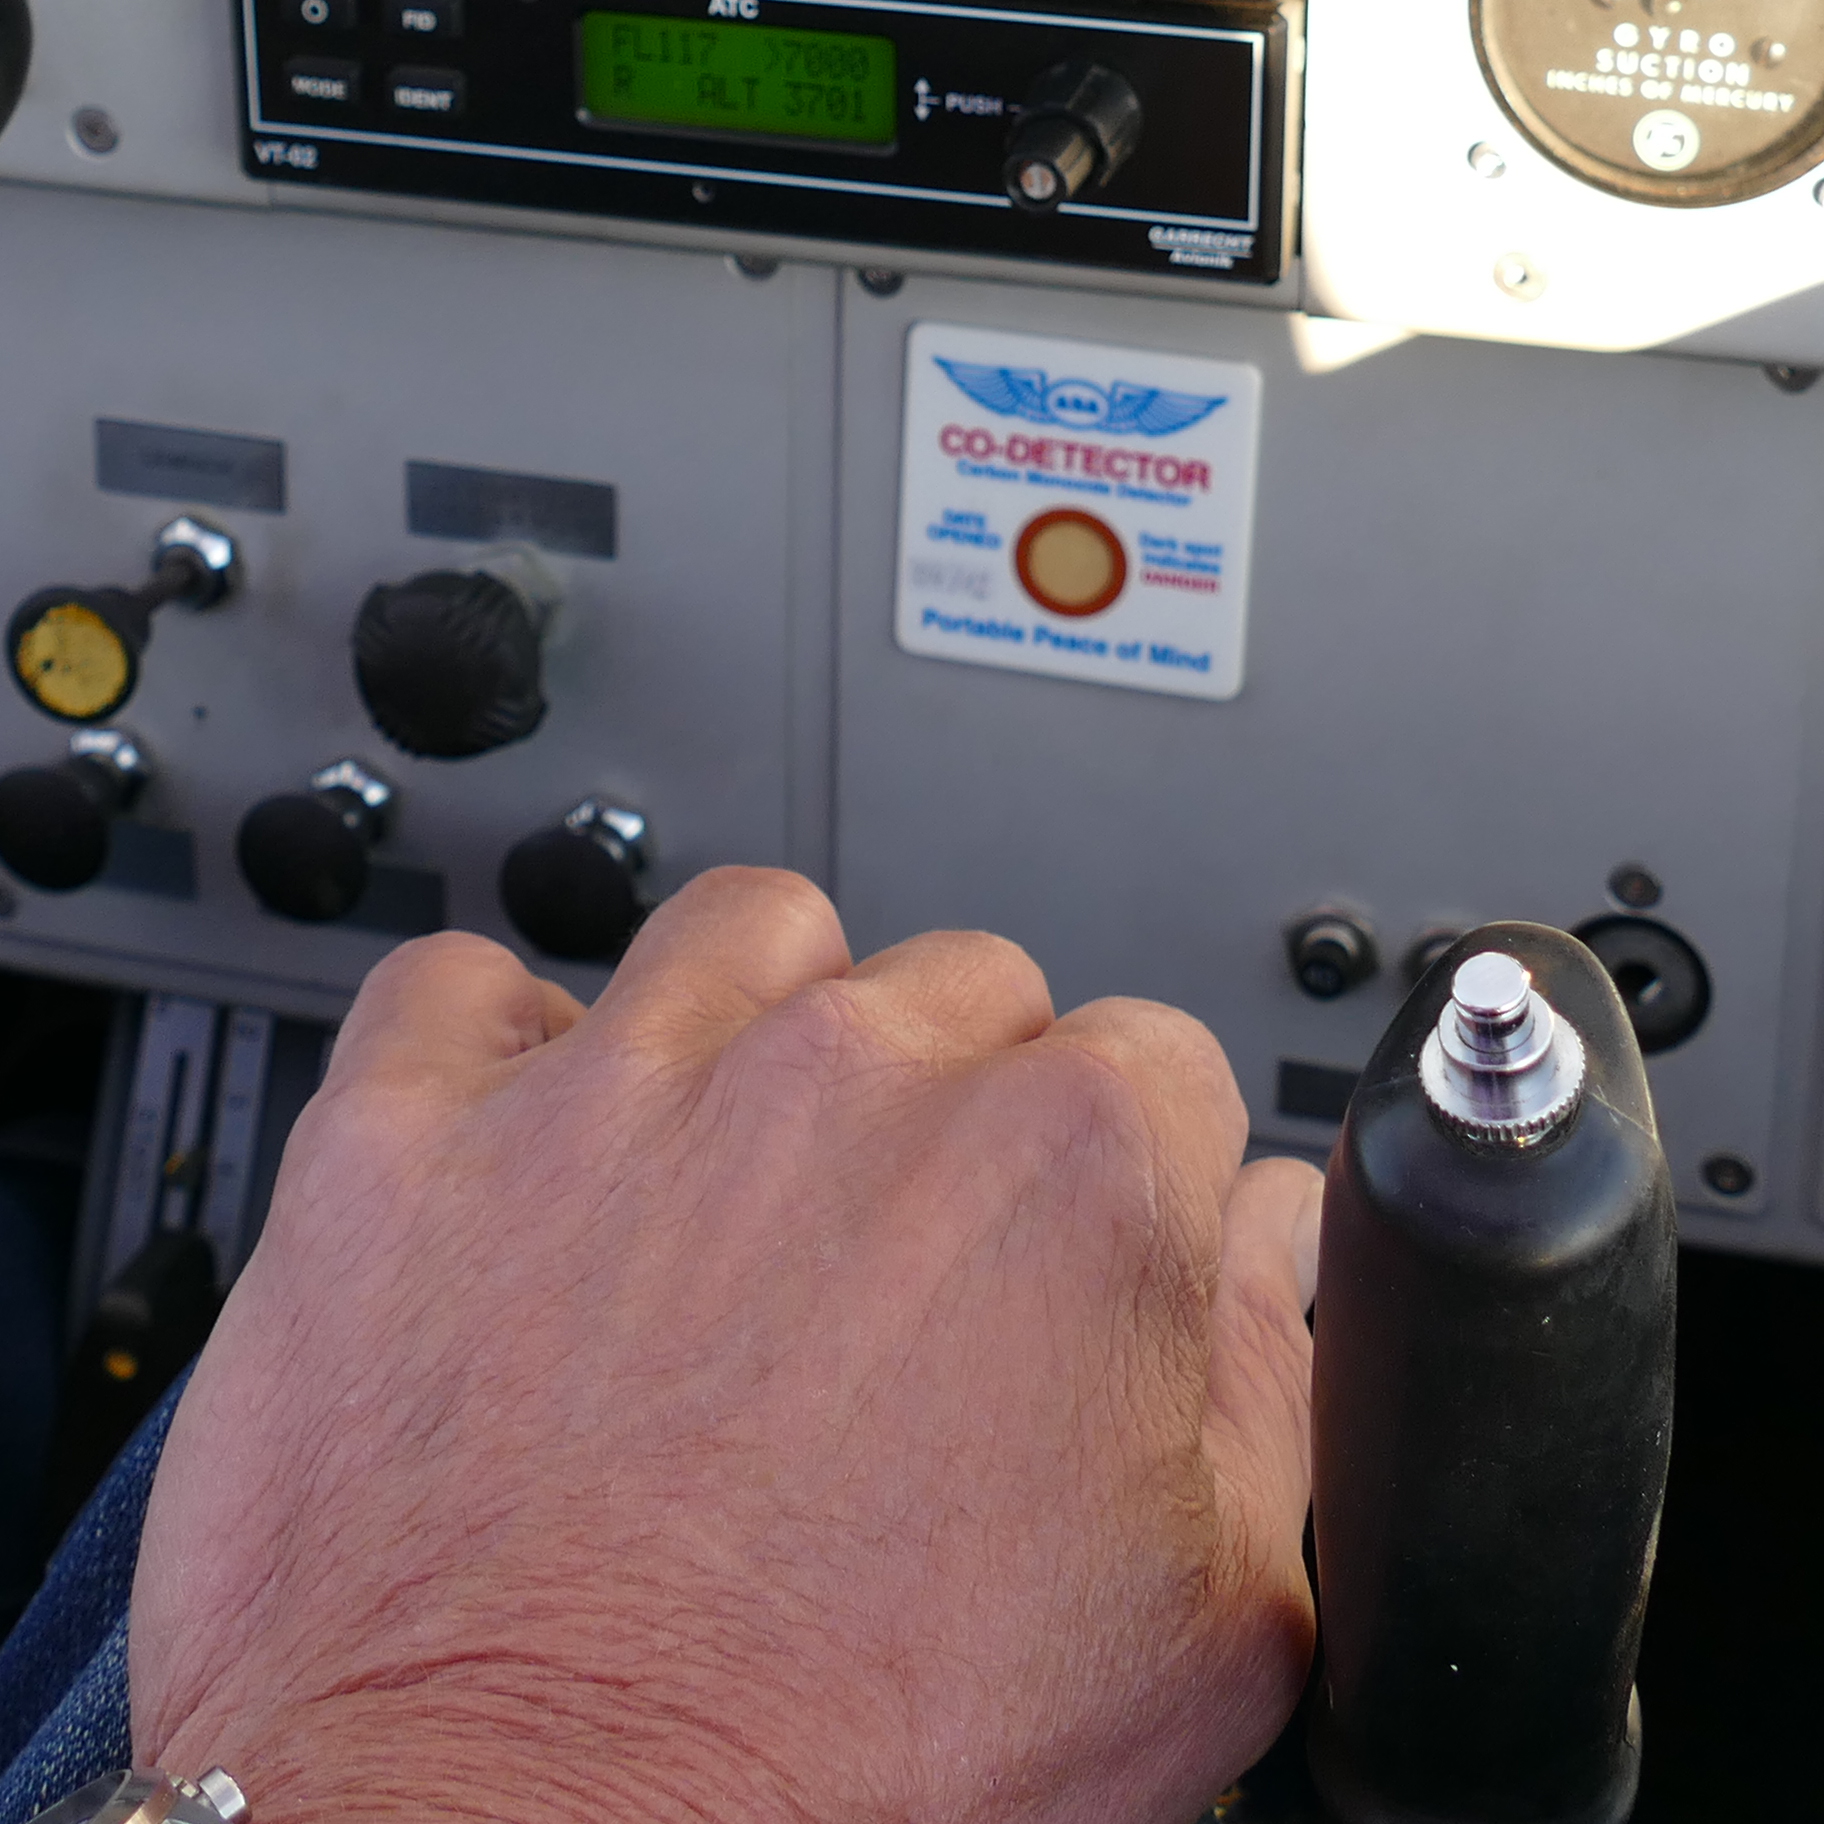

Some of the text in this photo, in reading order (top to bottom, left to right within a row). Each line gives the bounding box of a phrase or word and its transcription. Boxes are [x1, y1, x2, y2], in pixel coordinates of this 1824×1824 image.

[1596, 47, 1752, 88] SUCTION
[945, 92, 1005, 116] PUSH
[1680, 83, 1796, 114] MERCURY
[938, 423, 1212, 491] CO-DETECTOR
[957, 459, 1193, 507] Carbon Monoxide Detector
[922, 608, 1211, 673] Portable Peace of Mind
